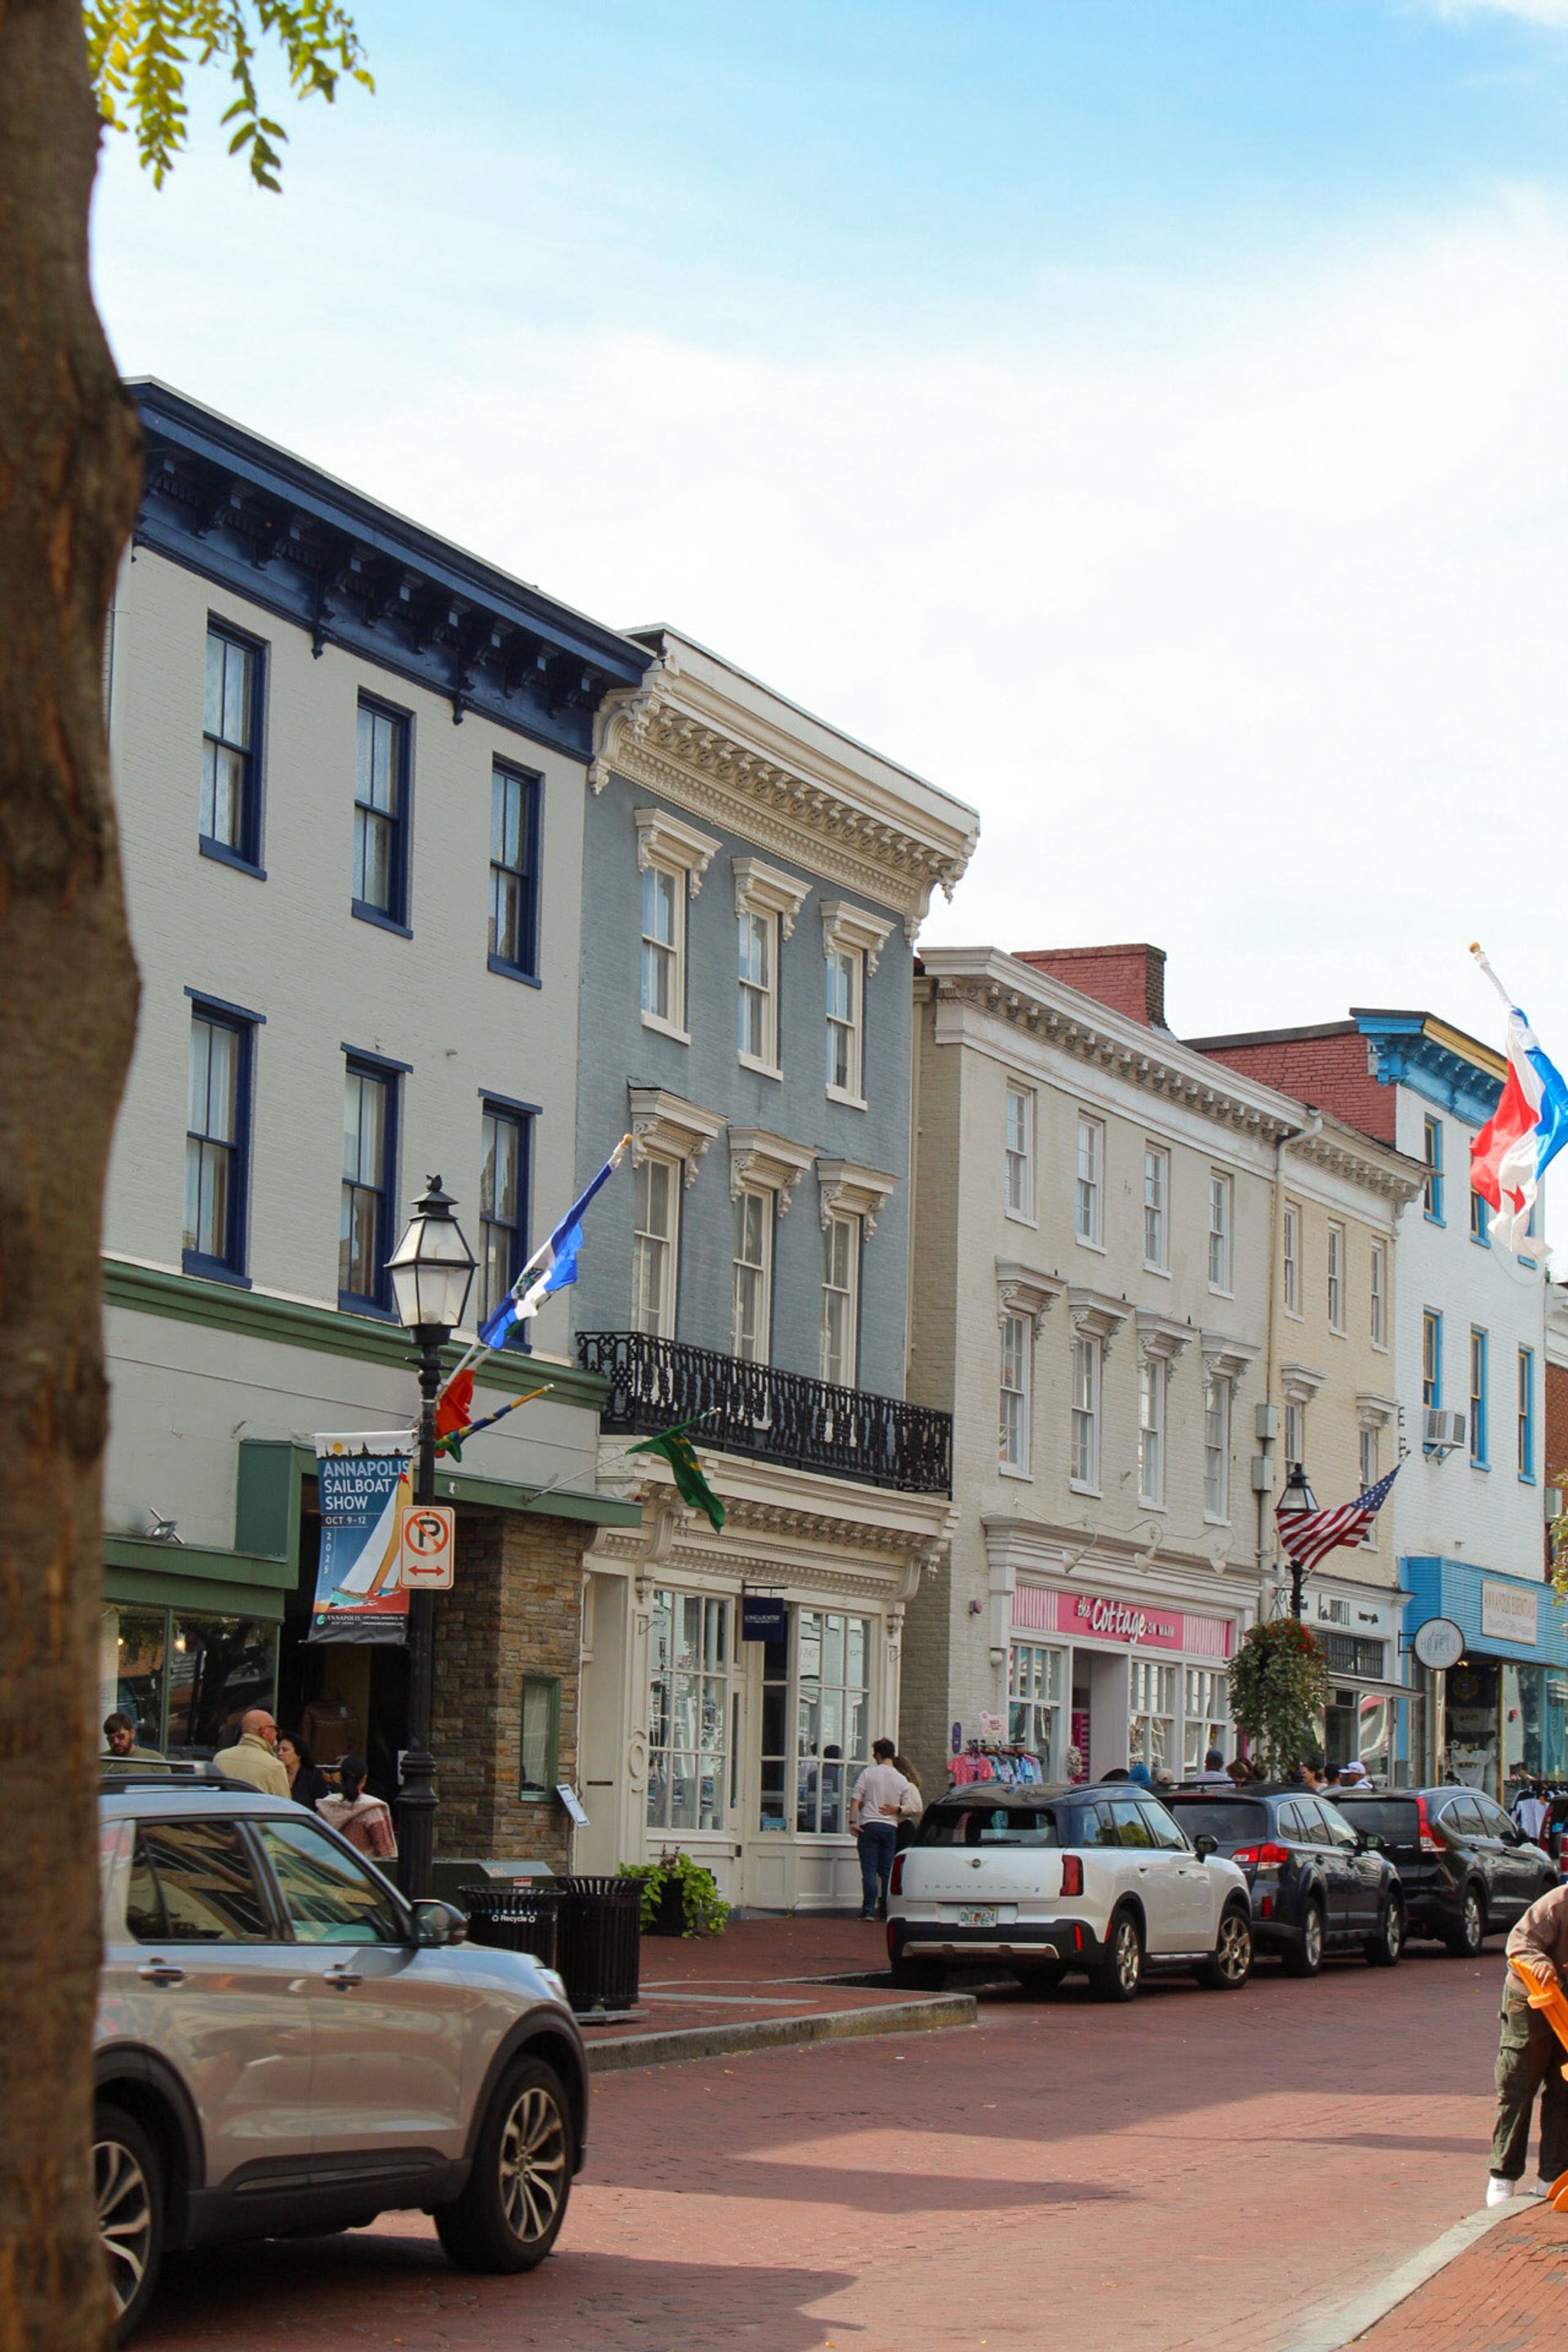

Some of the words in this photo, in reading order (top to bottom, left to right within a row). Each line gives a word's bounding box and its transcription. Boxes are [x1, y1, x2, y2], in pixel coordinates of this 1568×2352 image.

[323, 1461, 408, 1477] ANNAPOLIS
[324, 1479, 392, 1494] SAILBOAT
[325, 1496, 368, 1511] SHOW
[326, 1517, 343, 1525] OCT
[347, 1517, 367, 1525] 9-12
[1077, 1597, 1091, 1618] the
[1092, 1598, 1147, 1645] Cottage
[500, 1914, 528, 1923] Recycle
